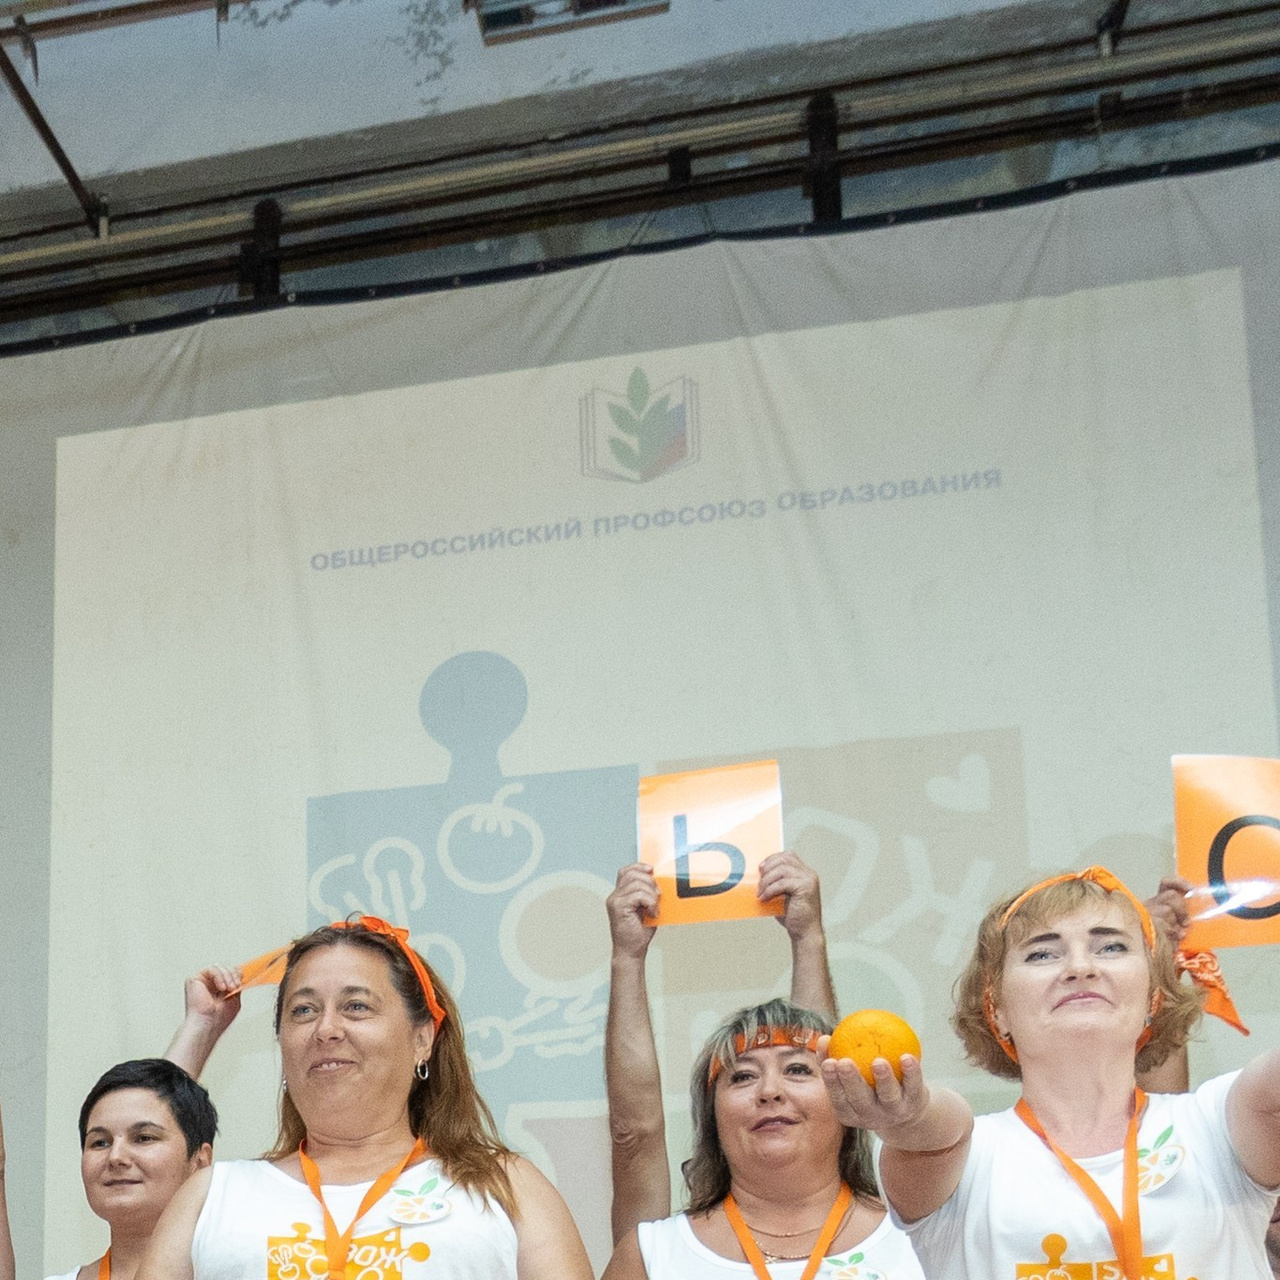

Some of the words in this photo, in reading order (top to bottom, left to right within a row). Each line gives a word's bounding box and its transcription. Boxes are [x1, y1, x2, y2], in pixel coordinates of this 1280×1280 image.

[310, 516, 583, 571] ОБЩЕРОССИЙСКИЙ
[593, 500, 767, 537] ПРОФСОЮЗ
[777, 469, 1003, 512] ОБРАЗОВАНИЯ
